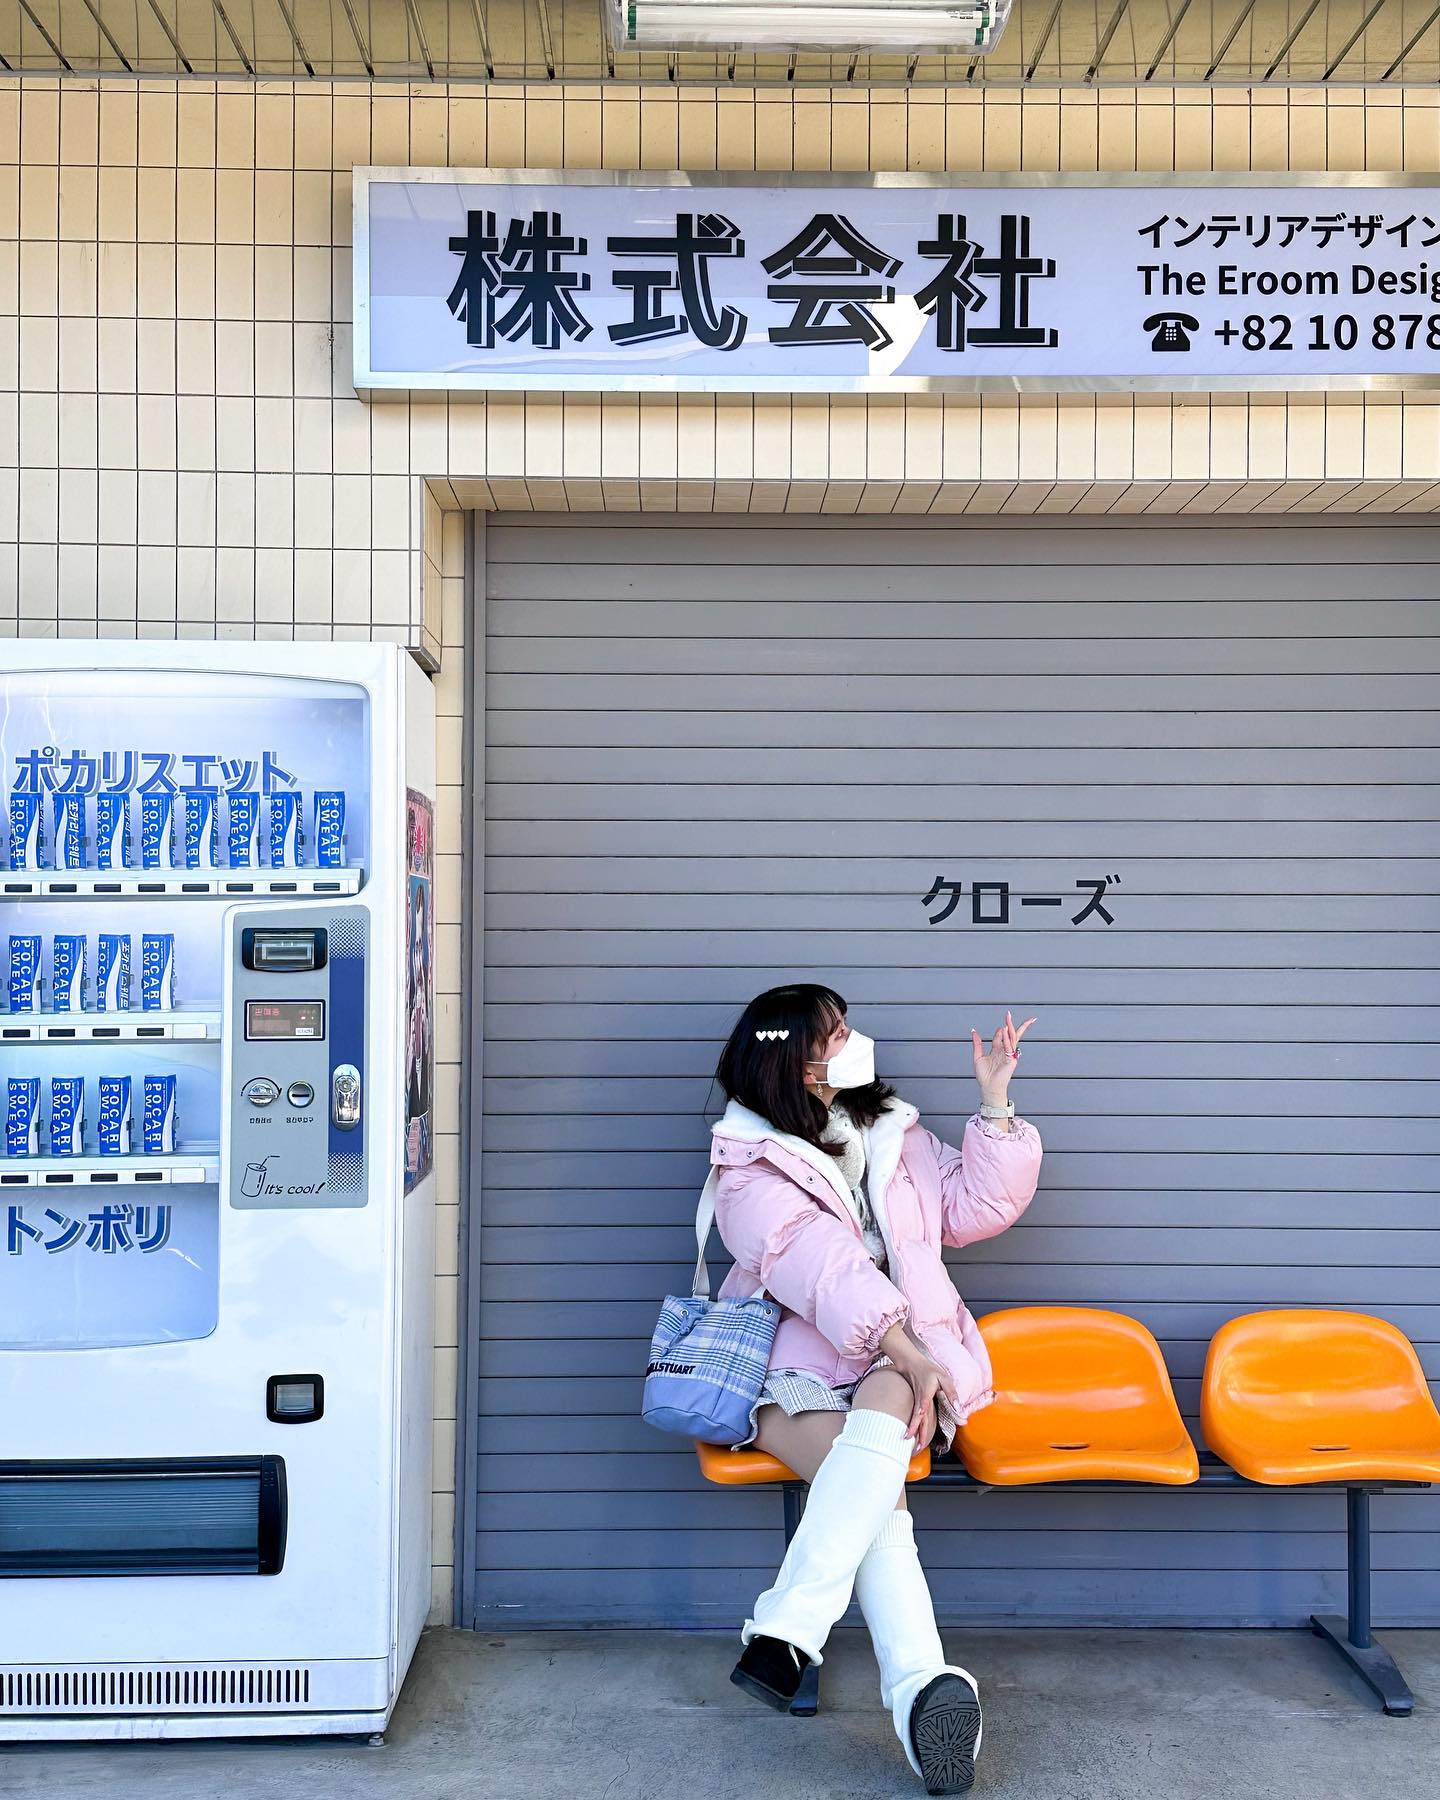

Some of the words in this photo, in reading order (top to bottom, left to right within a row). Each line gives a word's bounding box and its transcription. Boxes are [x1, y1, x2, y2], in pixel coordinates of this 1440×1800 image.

[1138, 212, 1440, 249] インテリアデザイン
[446, 210, 1058, 352] 株式会社
[1137, 263, 1206, 295] The
[1218, 265, 1339, 295] Eroom
[1214, 314, 1293, 351] +82
[1308, 314, 1358, 351] 10
[12, 745, 298, 798] ポカリスエット
[15, 799, 25, 866] POCARI
[101, 799, 110, 866] POCARI
[149, 799, 159, 865] POCARI
[190, 799, 199, 865] POCARI
[231, 799, 239, 858] SWEAT
[239, 798, 249, 865] POCARI
[274, 798, 283, 865] POCARI
[321, 798, 330, 857] SWEAT
[330, 798, 340, 864] POCARI
[921, 874, 1121, 926] クローズ
[12, 939, 20, 1003] SWEAT
[21, 939, 31, 1010] POCARI
[60, 942, 69, 1009] POCARI
[98, 941, 106, 1008] POCARI
[150, 941, 160, 1007] POCARI
[9, 1082, 17, 1147] SWEAT
[16, 1082, 28, 1154] POCARI
[52, 1082, 60, 1146] SWEAT
[60, 1081, 71, 1153] POCARI
[101, 1084, 109, 1144] SWEAT
[109, 1083, 120, 1151] POCARI
[144, 1083, 152, 1143] SWEAT
[152, 1082, 162, 1150] POCARI
[264, 1183, 284, 1195] It's
[287, 1181, 326, 1195] cool!
[8, 1204, 172, 1255] トンボリ
